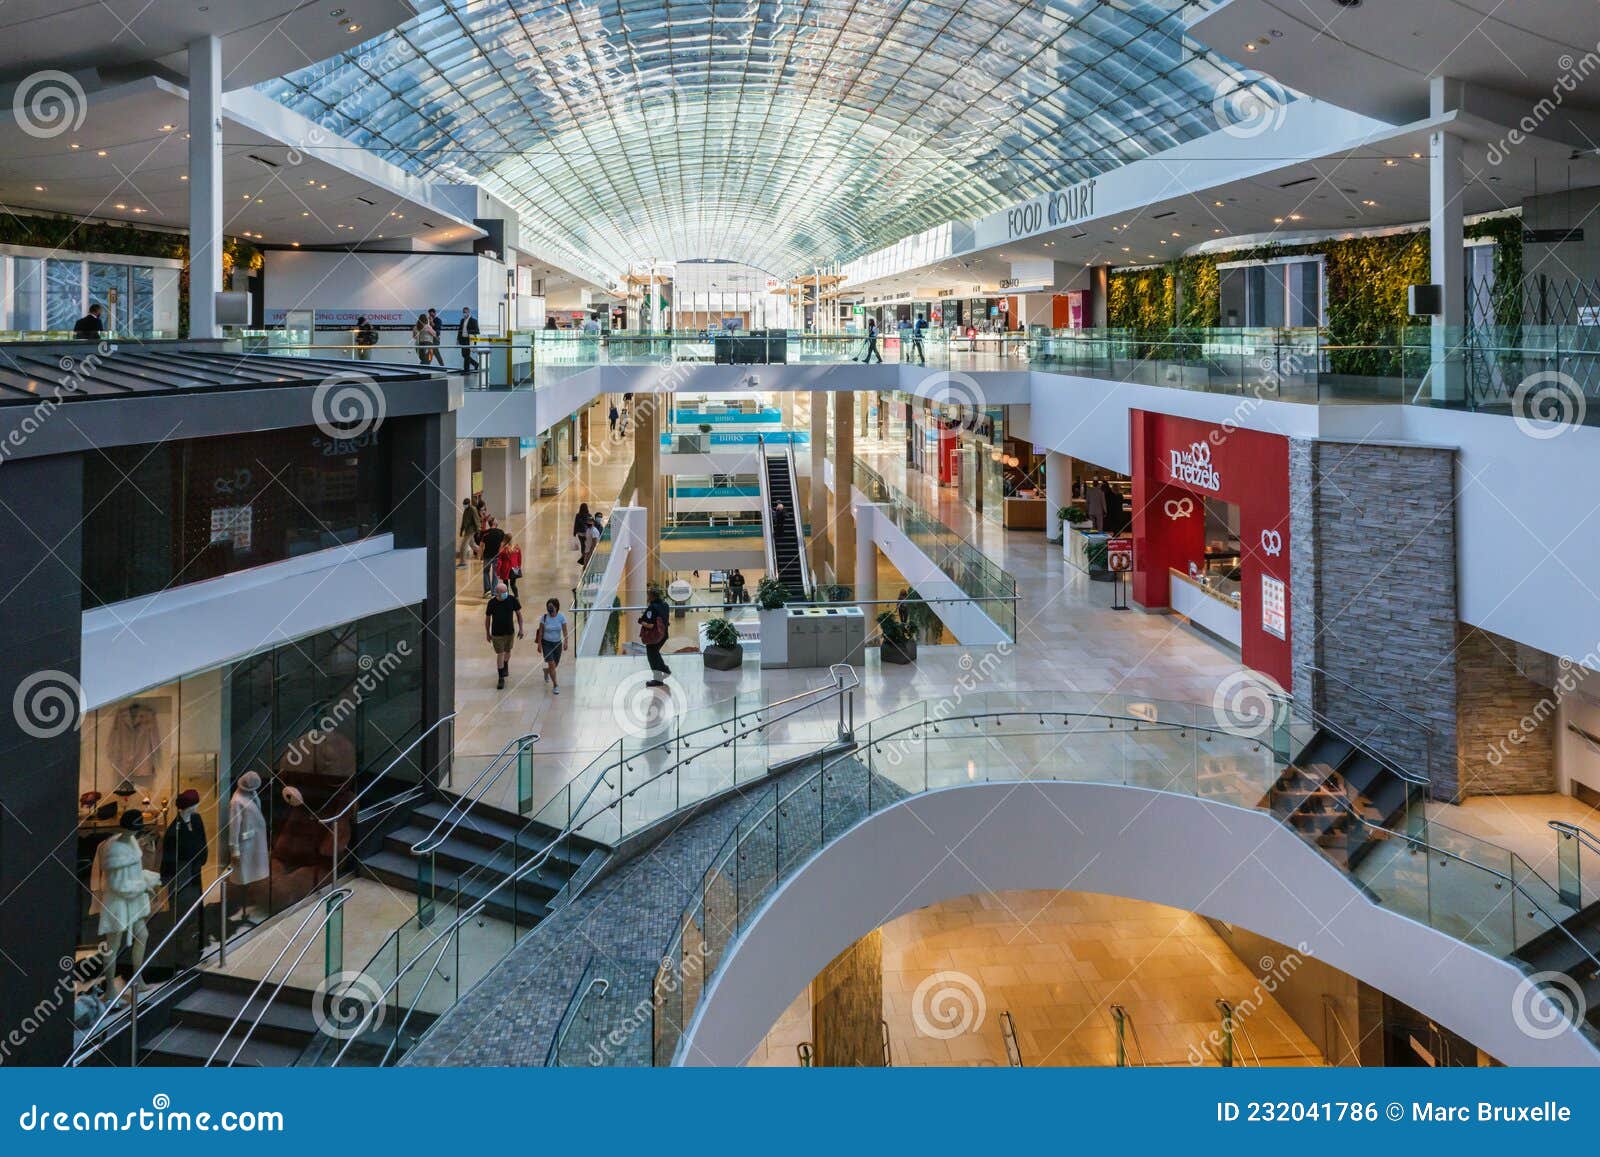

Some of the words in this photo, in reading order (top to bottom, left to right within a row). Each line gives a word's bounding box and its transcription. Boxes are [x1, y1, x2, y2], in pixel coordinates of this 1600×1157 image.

[1008, 202, 1042, 239] FOOD
[1048, 179, 1096, 226] COURT
[273, 313, 334, 321] INTCING
[1170, 450, 1220, 491] Pretzels
